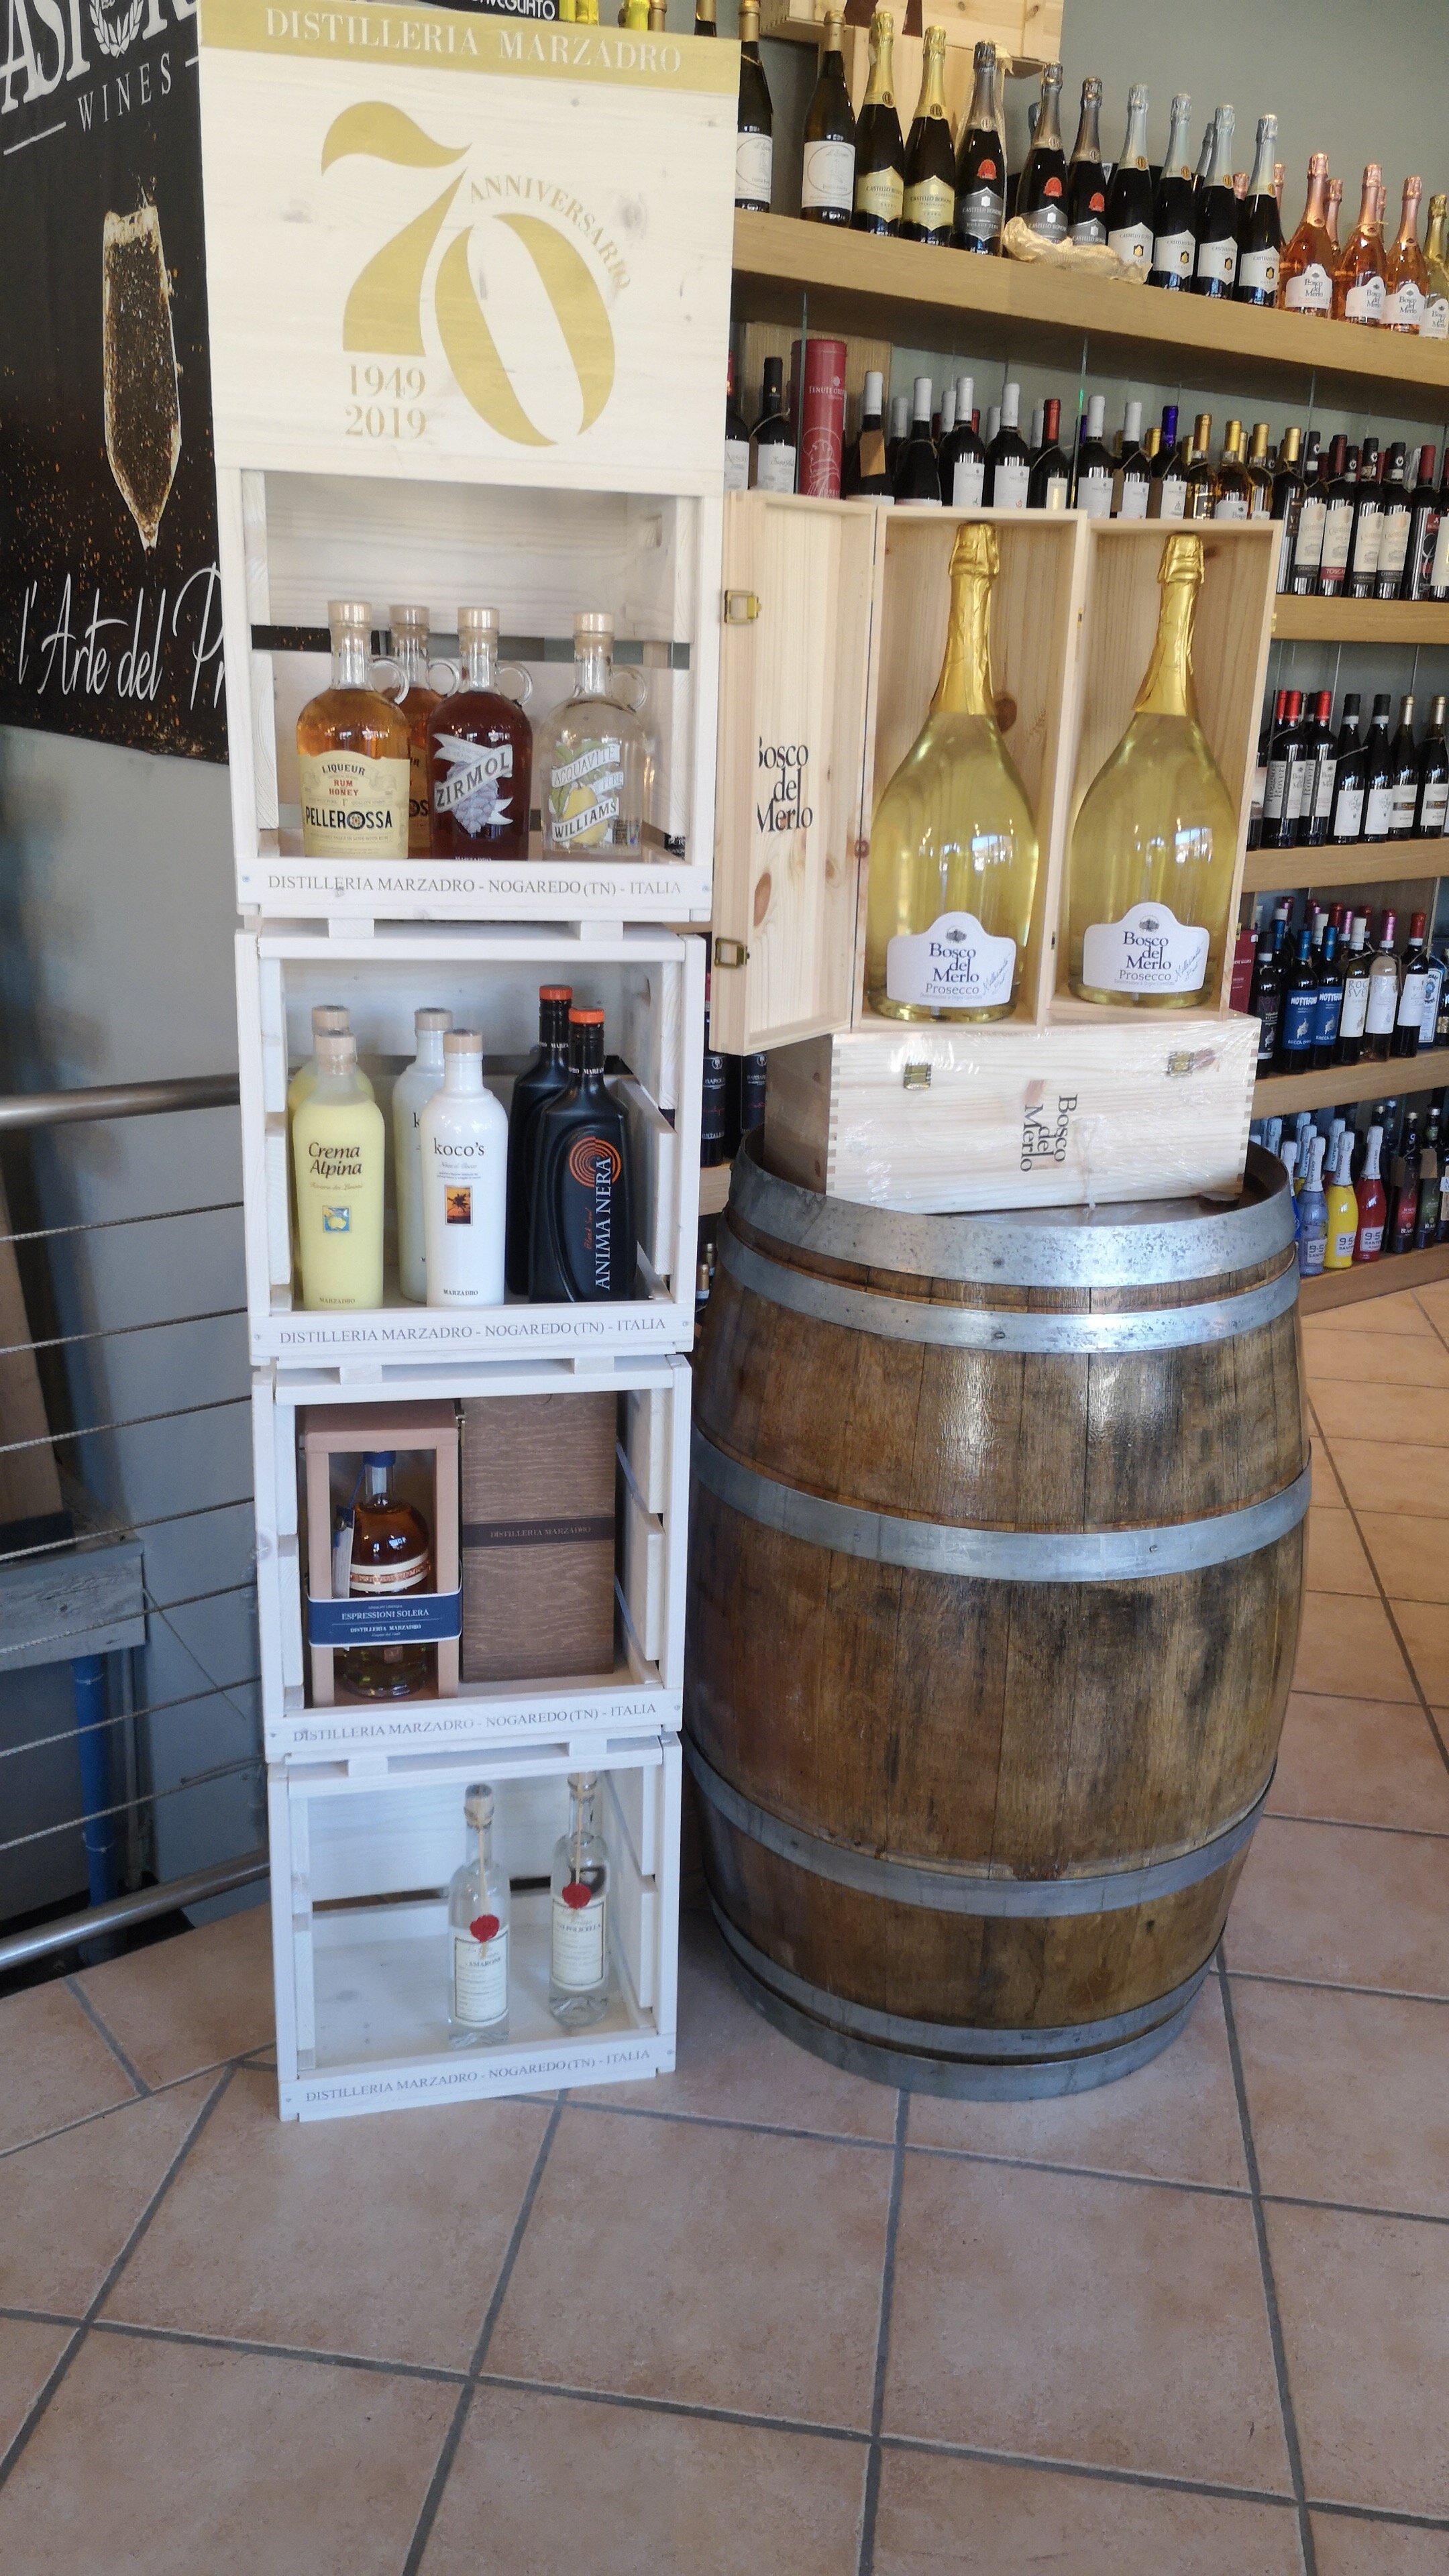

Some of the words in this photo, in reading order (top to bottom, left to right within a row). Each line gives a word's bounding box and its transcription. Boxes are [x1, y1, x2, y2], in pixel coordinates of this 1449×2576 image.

[266, 7, 478, 56] DISTILLERIA
[500, 30, 682, 74] MARZADRO
[77, 52, 172, 132] WINES
[470, 174, 631, 290] ANNIVERSARIO
[321, 101, 615, 447] 70
[349, 363, 426, 402] 1949
[344, 404, 427, 439] 2019
[19, 574, 128, 695] l'Arte
[118, 587, 166, 701] del
[322, 763, 366, 776] LIQUEUR
[436, 751, 510, 808] ZIRMOL
[329, 788, 359, 796] HONEY
[773, 767, 802, 802] del
[305, 806, 393, 830] PELLEROSSA
[554, 800, 617, 839] WILLIAMS
[268, 875, 374, 891] DISTILLERIA
[378, 877, 476, 892] MARZADRO
[488, 879, 581, 894] NOGAREDO
[584, 881, 616, 898] (TN)
[631, 881, 682, 894] ITALIA
[929, 942, 976, 958] Bosco
[1124, 930, 1169, 947] Bosco
[949, 955, 971, 972] del
[1126, 955, 1172, 970] Merlo
[1142, 945, 1163, 959] del
[932, 967, 979, 983] Merlo
[1119, 969, 1171, 981] Prosecco
[925, 983, 979, 995] Prosecco
[1020, 1104, 1044, 1172] Merlo
[1054, 1093, 1078, 1162] Bosco
[309, 1142, 361, 1159] Crema
[433, 1138, 485, 1157] koco's
[1037, 1126, 1057, 1155] del
[310, 1159, 362, 1179] Alpina
[595, 1157, 611, 1215] NERA
[595, 1218, 611, 1291] ANIMA
[319, 1297, 356, 1305] MARZADRO
[443, 1289, 479, 1297] MARZADRO
[280, 1330, 379, 1344] DISTILLERIA
[381, 1326, 473, 1341] MARZADRO
[485, 1322, 572, 1337] NOGAREDO
[574, 1321, 604, 1336] (TN)
[617, 1318, 666, 1332] ITALIA
[490, 1530, 543, 1538] DISTILLERIA
[545, 1526, 592, 1536] MARZADRO
[341, 1611, 395, 1620] ESPRESSIONI
[396, 1609, 429, 1617] SOLERA
[293, 1725, 386, 1741] DISTILLERIA
[388, 1719, 474, 1735] MARZADRO
[486, 1711, 568, 1727] NOGAREDO
[570, 1709, 598, 1723] (TN)
[610, 1703, 656, 1717] ITALIA
[306, 2082, 393, 2102] DISTILLERIA
[396, 2072, 478, 2090] MARZADRO
[488, 2060, 566, 2079] NOGAREDO
[568, 2057, 596, 2071] (TN)
[606, 2049, 650, 2064] ITALIA
